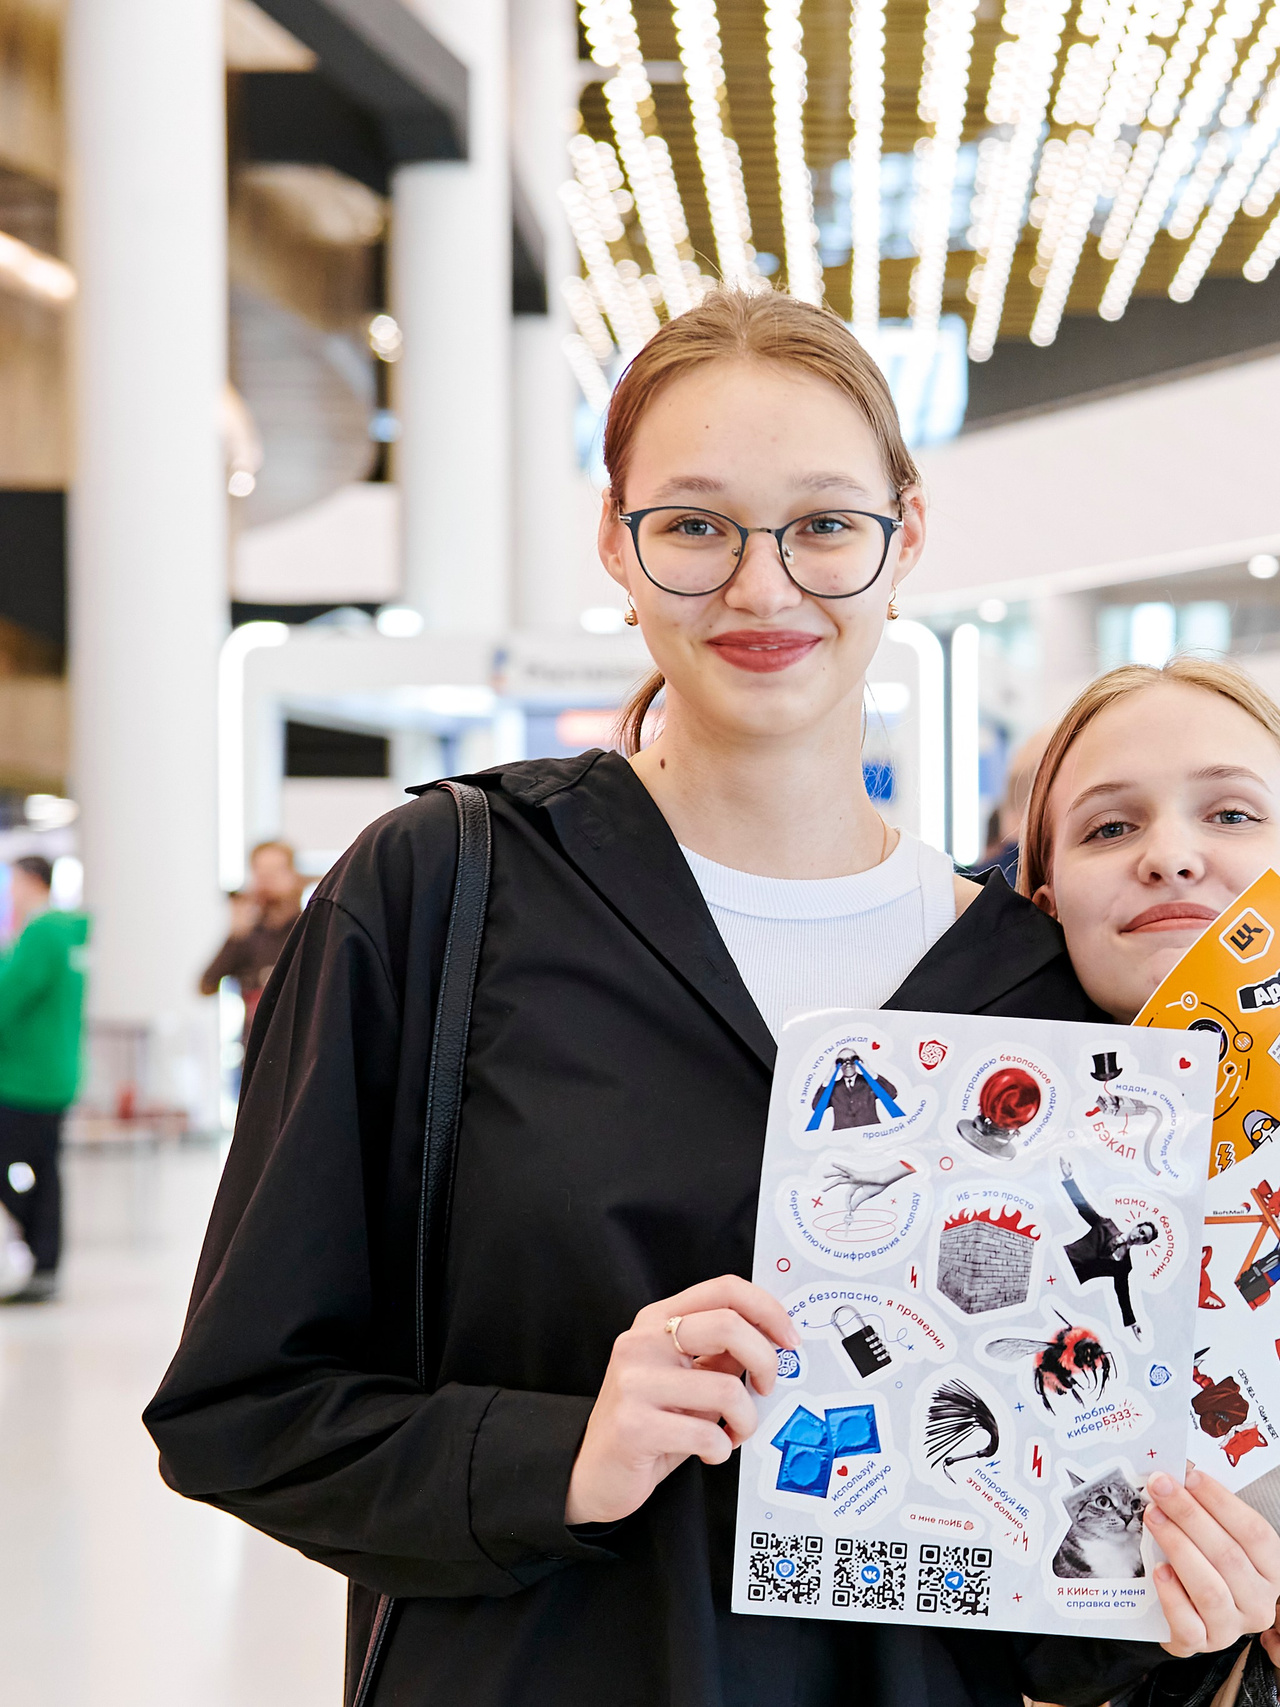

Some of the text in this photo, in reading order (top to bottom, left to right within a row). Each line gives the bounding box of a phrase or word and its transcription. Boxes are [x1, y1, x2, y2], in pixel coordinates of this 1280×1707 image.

[801, 1072, 816, 1097] знаю,
[814, 1057, 824, 1070] что
[824, 1045, 835, 1057] ты
[836, 1035, 868, 1048] лайкал
[962, 1054, 1056, 1147] настраиваю безопасное подключение
[1116, 1083, 1150, 1095] мадам,
[863, 1099, 927, 1139] прошлой ночью
[1160, 1094, 1177, 1126] снимаю
[1093, 1121, 1137, 1160] БЭКАП
[1160, 1129, 1176, 1156] перед
[1162, 1158, 1179, 1179] вами
[956, 1191, 971, 1202] ИБ
[982, 1190, 999, 1199] это
[1001, 1191, 1035, 1210] просто
[789, 1190, 921, 1262] береги ключи шифрования смолоду
[1115, 1197, 1175, 1280] мама, я безопасник
[787, 1291, 946, 1350] все безопасно, я проверил
[1074, 1403, 1116, 1424] люблю
[1237, 1368, 1249, 1385] СЕМЬ
[1246, 1386, 1256, 1399] БЕД
[1258, 1405, 1269, 1423] ОДИН
[1266, 1423, 1279, 1440] RESET
[831, 1460, 877, 1502] используй
[833, 1464, 891, 1518] проактивную
[855, 1484, 889, 1517] защиту
[974, 1467, 1030, 1520] попробуй ИБ,
[918, 1514, 935, 1524] мне
[938, 1518, 962, 1529] поИБ
[965, 1476, 1024, 1530] это не больно
[1057, 1588, 1064, 1596] Я
[1067, 1588, 1100, 1597] КИИст
[1111, 1589, 1118, 1598] у
[1066, 1600, 1136, 1609] справка есть
